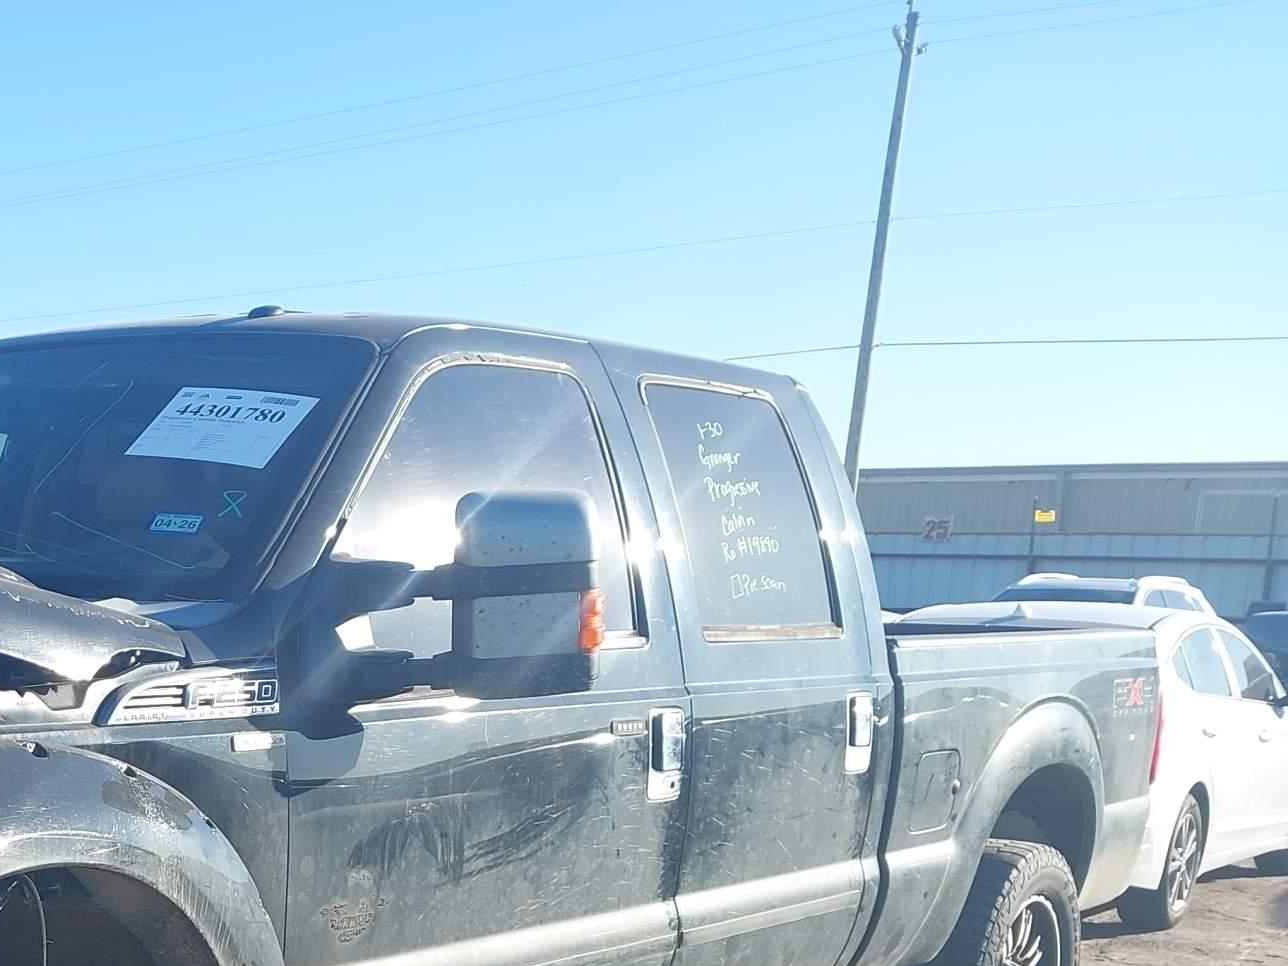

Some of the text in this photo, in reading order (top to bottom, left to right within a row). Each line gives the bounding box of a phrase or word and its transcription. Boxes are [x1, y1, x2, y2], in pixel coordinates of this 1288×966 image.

[176, 402, 286, 424] 44301780
[923, 519, 950, 540] 25
[123, 706, 278, 721] LARIAT SUPER DUTY
